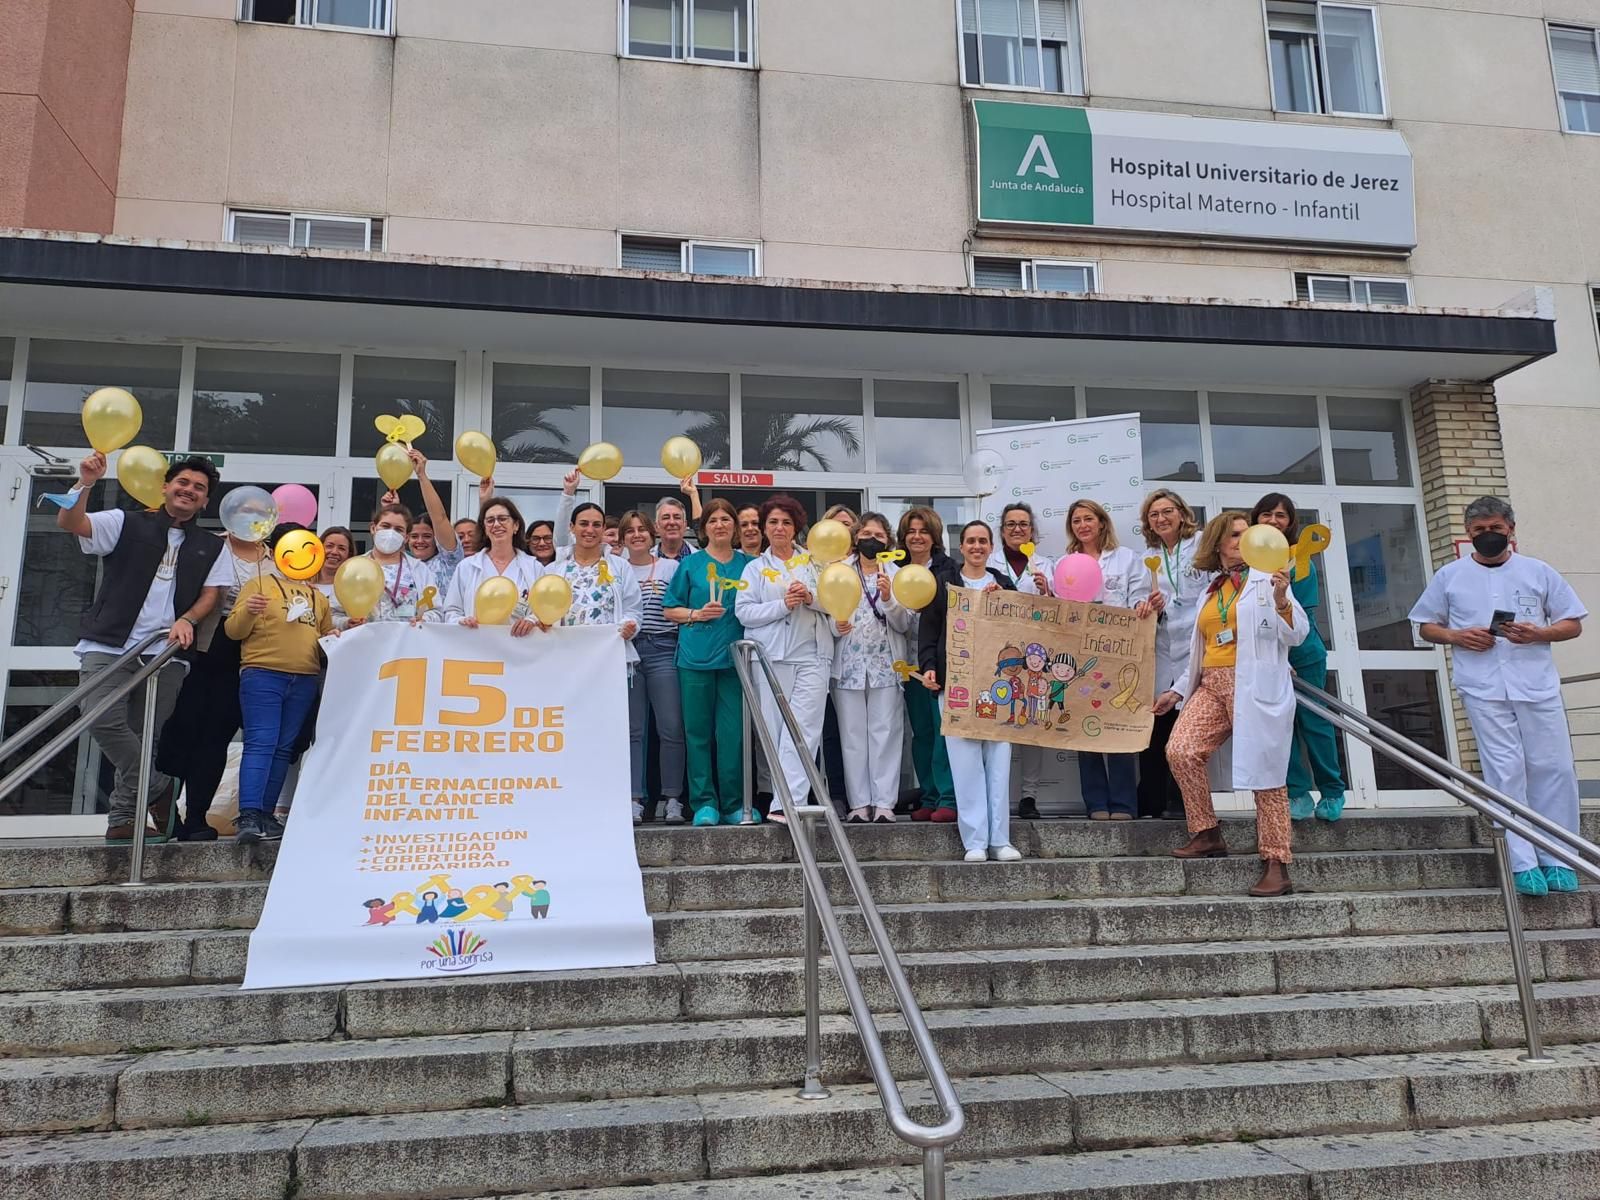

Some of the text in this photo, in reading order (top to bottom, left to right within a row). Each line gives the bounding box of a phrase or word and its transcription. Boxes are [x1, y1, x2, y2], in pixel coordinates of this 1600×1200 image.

[1110, 157, 1399, 191] Hospital Universitario de Jerez
[990, 180, 1084, 194] Junta de Andalucía
[1111, 189, 1192, 213] Hospital
[1198, 194, 1277, 216] Materno
[1294, 200, 1360, 220] Infantil
[713, 473, 758, 484] SALIDA
[984, 594, 1061, 625] Internacional
[1083, 633, 1137, 657] Infantil
[378, 657, 565, 729] 15 DE
[948, 686, 970, 710] 15
[370, 730, 564, 753] FEBRERO
[369, 760, 412, 777] DÍA
[368, 776, 564, 792] INTERNACIONAL
[366, 791, 514, 806] DEL CÁNCER
[364, 808, 480, 821] INFANTIL
